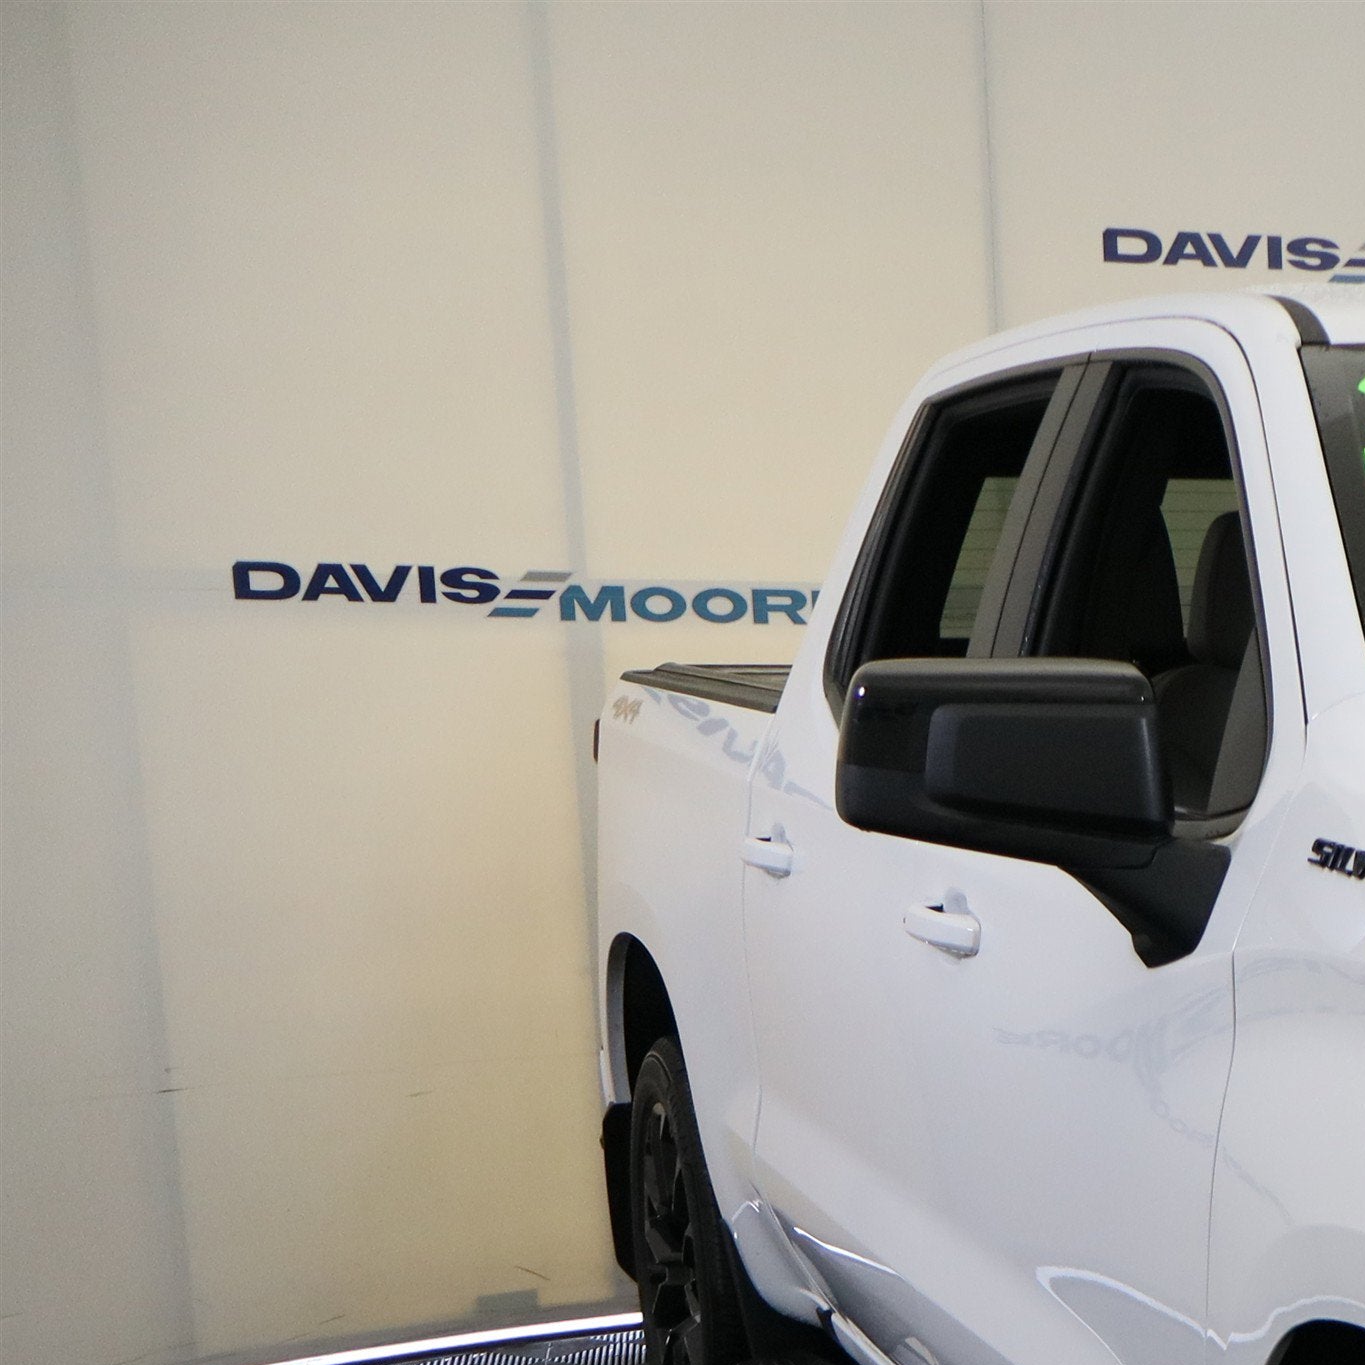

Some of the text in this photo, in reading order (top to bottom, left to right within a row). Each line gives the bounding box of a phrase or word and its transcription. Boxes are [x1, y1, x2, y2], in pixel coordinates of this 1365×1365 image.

[1102, 227, 1341, 272] DAVIS
[231, 560, 822, 626] DAVIS MOOR
